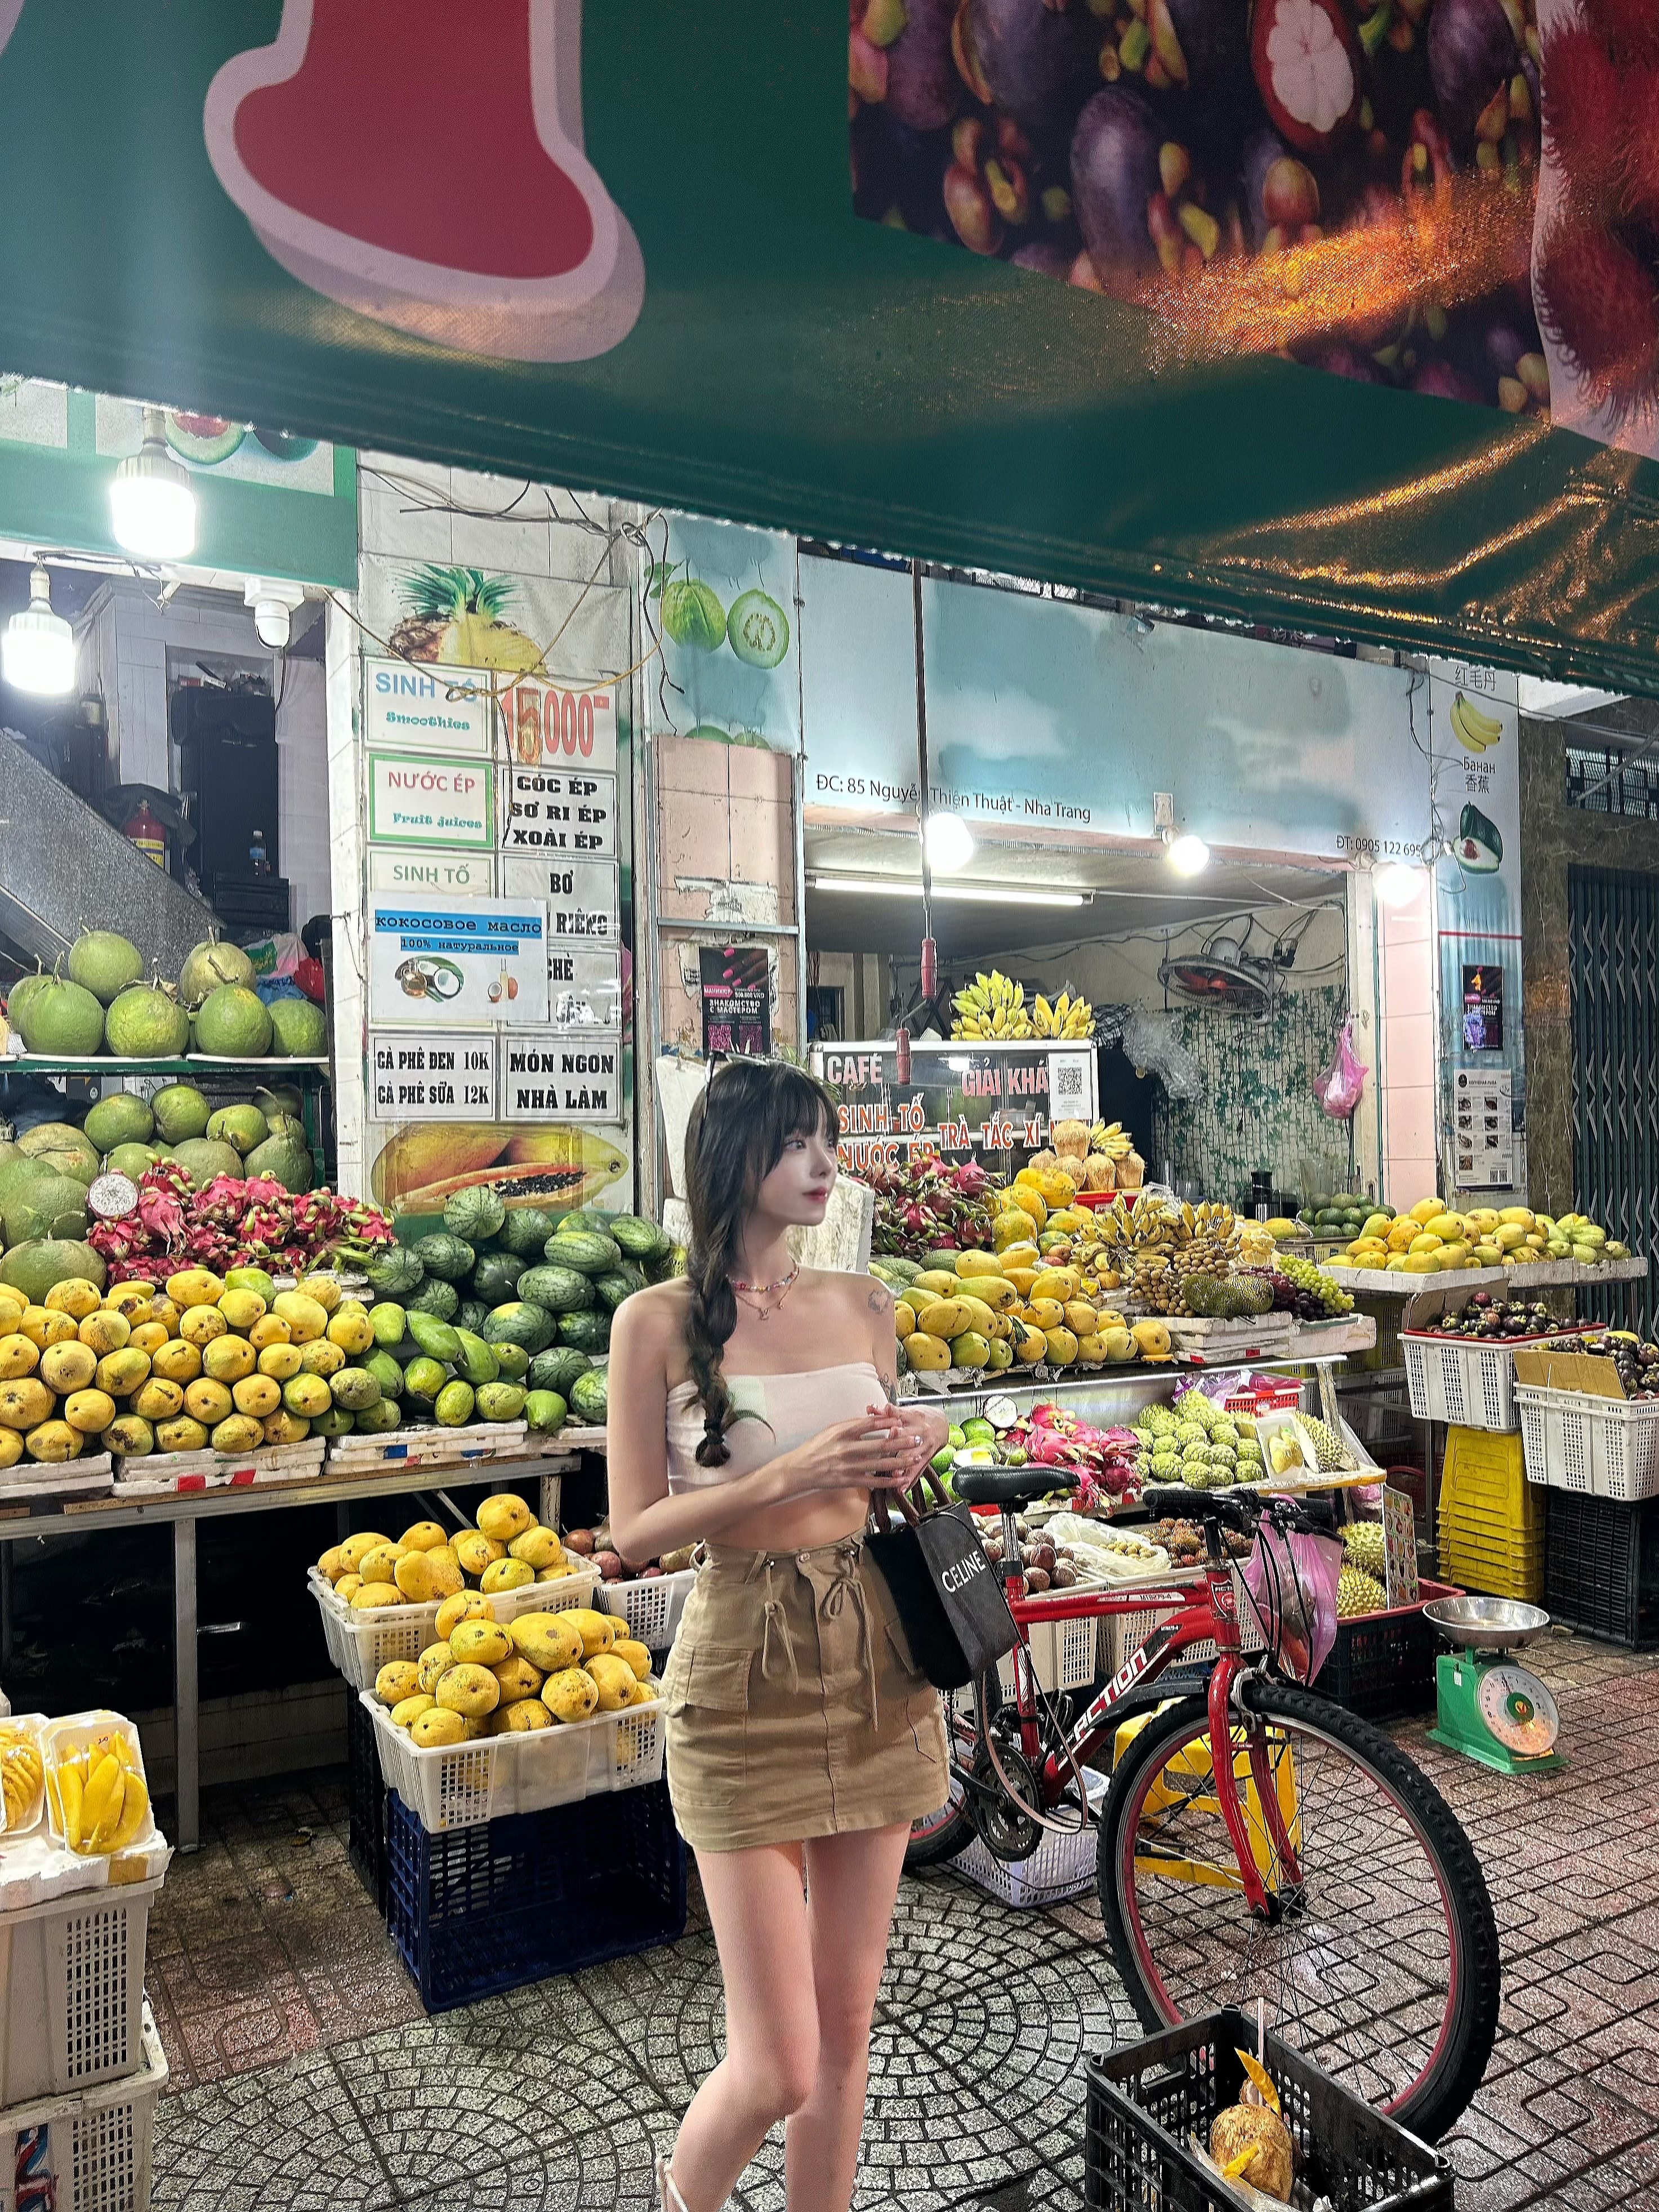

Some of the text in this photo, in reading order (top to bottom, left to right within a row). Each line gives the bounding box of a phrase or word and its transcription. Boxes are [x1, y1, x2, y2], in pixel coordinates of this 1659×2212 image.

[376, 672, 435, 698] SINH
[1455, 665, 1496, 691] 红毛丹
[386, 711, 470, 730] Smoothies
[1464, 756, 1496, 775] Банан
[389, 771, 475, 793] NƯỚC ÉP
[517, 775, 597, 796] CÓC ÉP
[1465, 773, 1490, 794] 香蕉
[816, 774, 843, 792] ĐC:
[848, 777, 865, 795] 85
[870, 780, 920, 804] Nguyễ
[930, 787, 969, 809] Thiện
[973, 793, 1013, 815] Thuật
[1024, 798, 1051, 817] Nha
[1054, 802, 1091, 824] Trang
[393, 812, 483, 830] Fruit juices
[511, 800, 607, 824] SƠ RI ÉP
[513, 827, 603, 850] XOÀI ÉP
[1336, 835, 1353, 850] ĐT:
[1355, 838, 1380, 853] 0905
[1383, 840, 1401, 855] 122
[393, 862, 470, 884] SINH TỐ
[550, 870, 573, 894] BƠ
[375, 916, 477, 931] кокосовое
[488, 921, 542, 933] масло
[402, 938, 519, 952] 100% натуральное
[709, 999, 760, 1008] ЗНАКОМСТВО
[717, 1006, 758, 1014] МАСТЕРОМ
[377, 1045, 490, 1070] CÀ PHÊ ĐEN 10K
[510, 1048, 555, 1073] MÓN
[827, 1052, 1050, 1097] CAFÉ GIẢI KHÁ
[378, 1080, 490, 1104] CÀ PHÊ SỮA 12K
[516, 1084, 608, 1110] NHÀ LÀM
[837, 1092, 925, 1133] SINH TỐ
[937, 1114, 973, 1151] TRÀ
[980, 1111, 1014, 1150] TẮC
[1023, 1112, 1043, 1148] XÍ
[837, 1133, 902, 1172] NƯỚC
[942, 1550, 987, 1593] CELINE
[1073, 1646, 1148, 1742] ACTION
